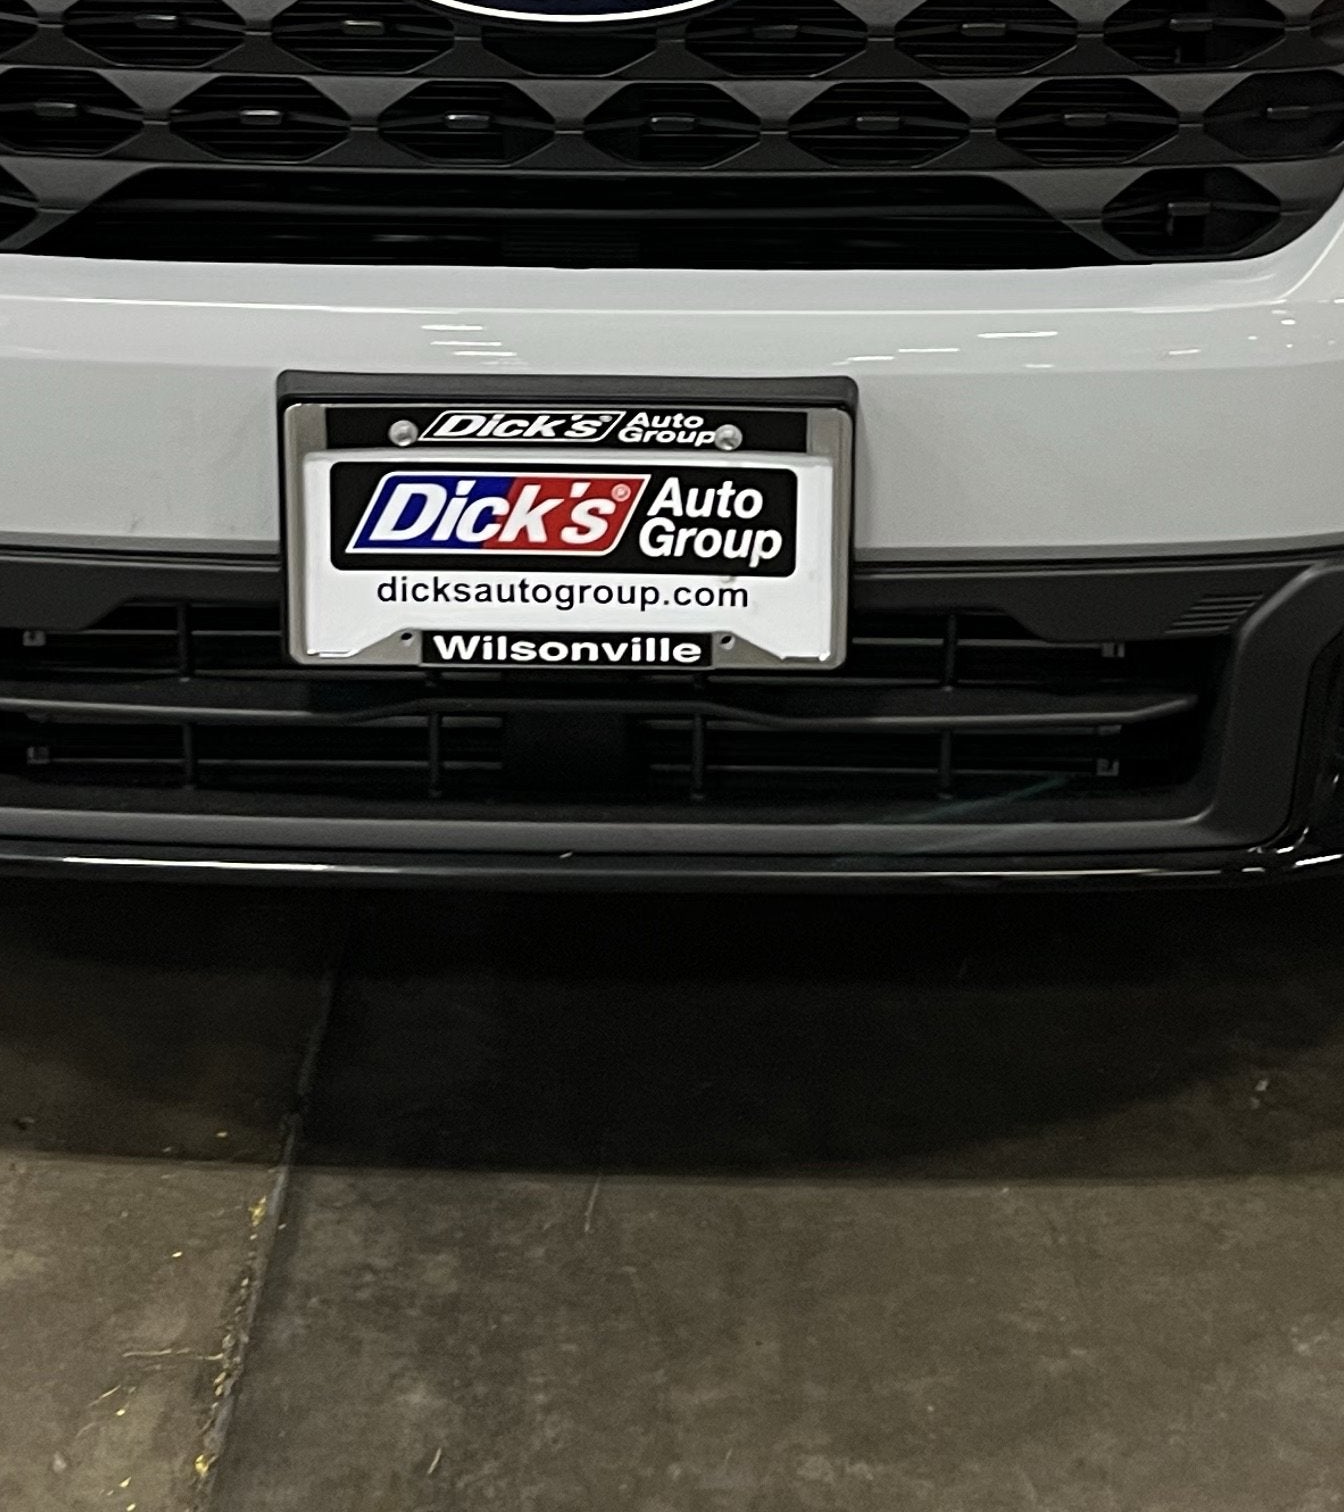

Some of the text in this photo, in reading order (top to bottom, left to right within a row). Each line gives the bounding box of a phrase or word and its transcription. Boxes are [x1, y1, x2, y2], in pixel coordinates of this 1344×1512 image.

[432, 412, 604, 439] Dick's
[618, 427, 716, 447] Group
[626, 412, 705, 430] Auto
[367, 479, 619, 545] Dick's
[647, 476, 763, 519] Auto
[639, 516, 784, 568] Group
[376, 575, 749, 612] dicksautogroup.com
[432, 634, 703, 664] Wilsonville
